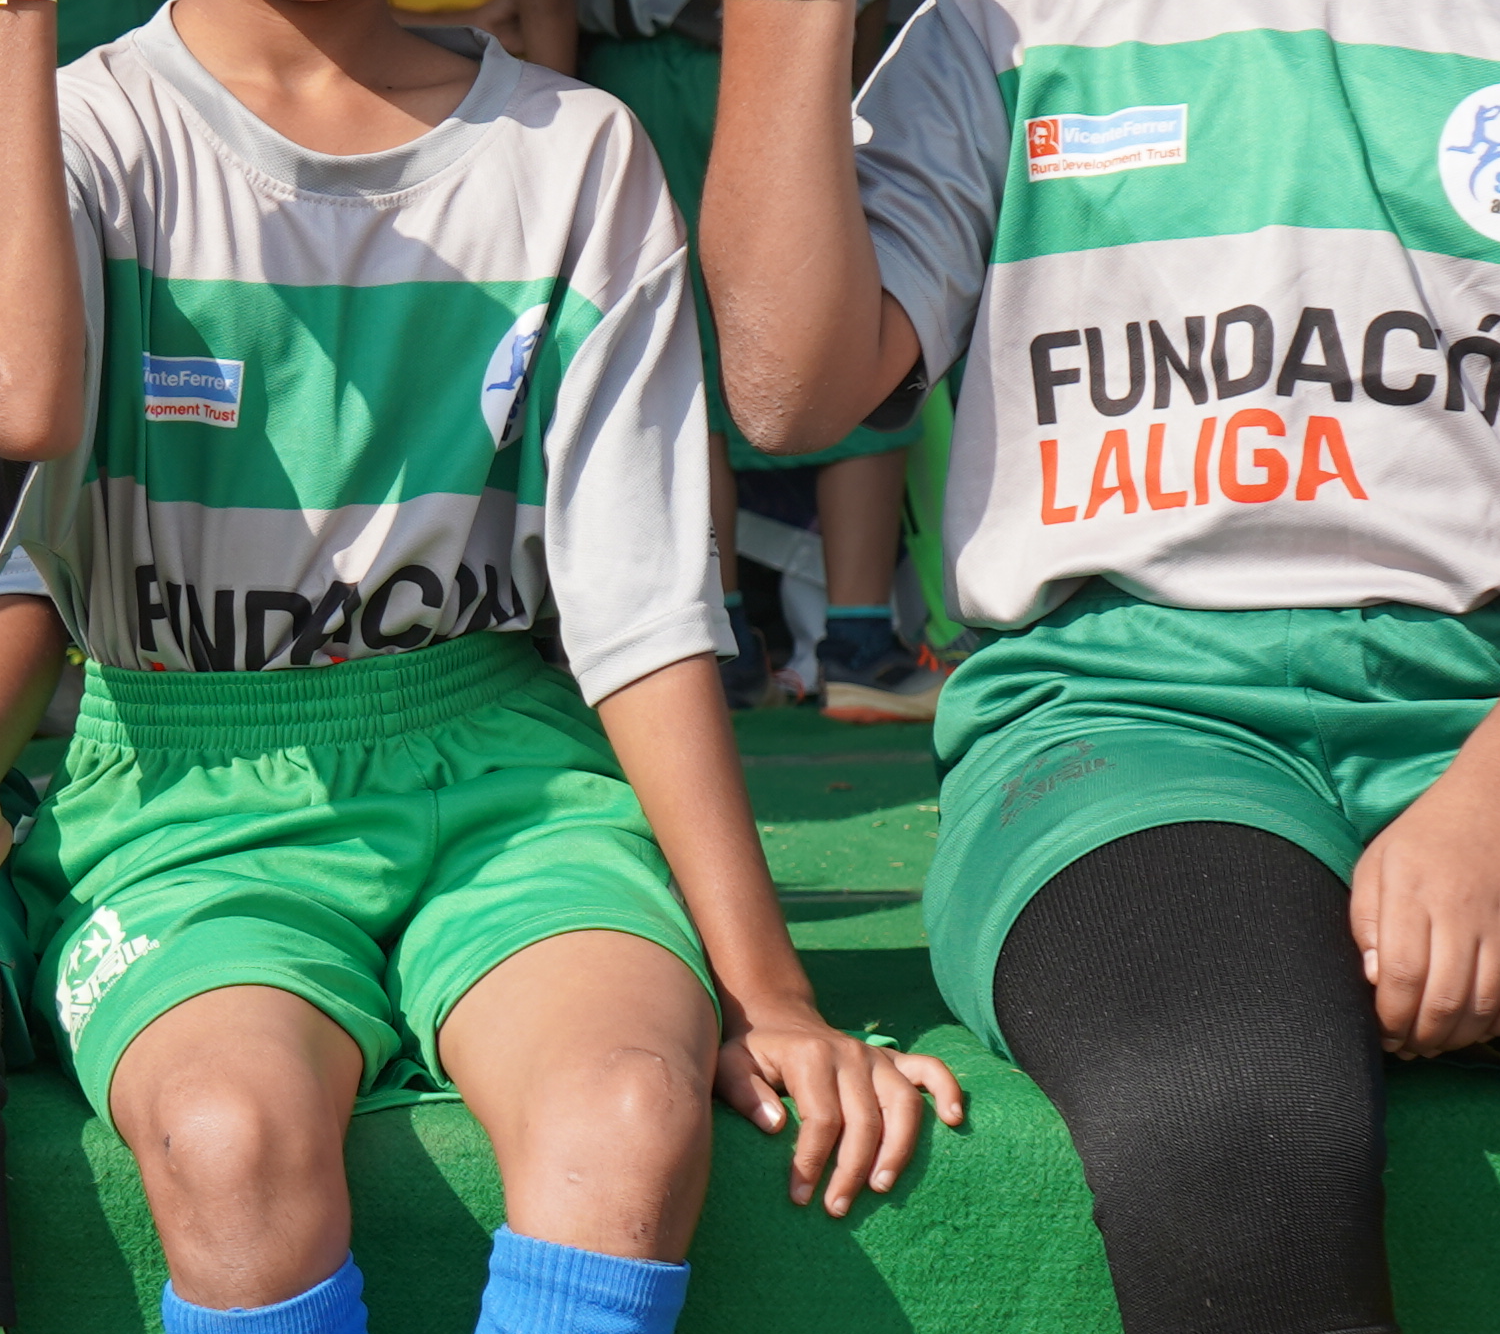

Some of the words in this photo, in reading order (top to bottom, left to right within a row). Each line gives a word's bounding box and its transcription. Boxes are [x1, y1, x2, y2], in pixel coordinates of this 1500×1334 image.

[1063, 120, 1177, 144] VicenteFerrer
[1146, 147, 1181, 161] Trust
[203, 404, 236, 421] Trust
[1039, 408, 1368, 525] LALIGA
